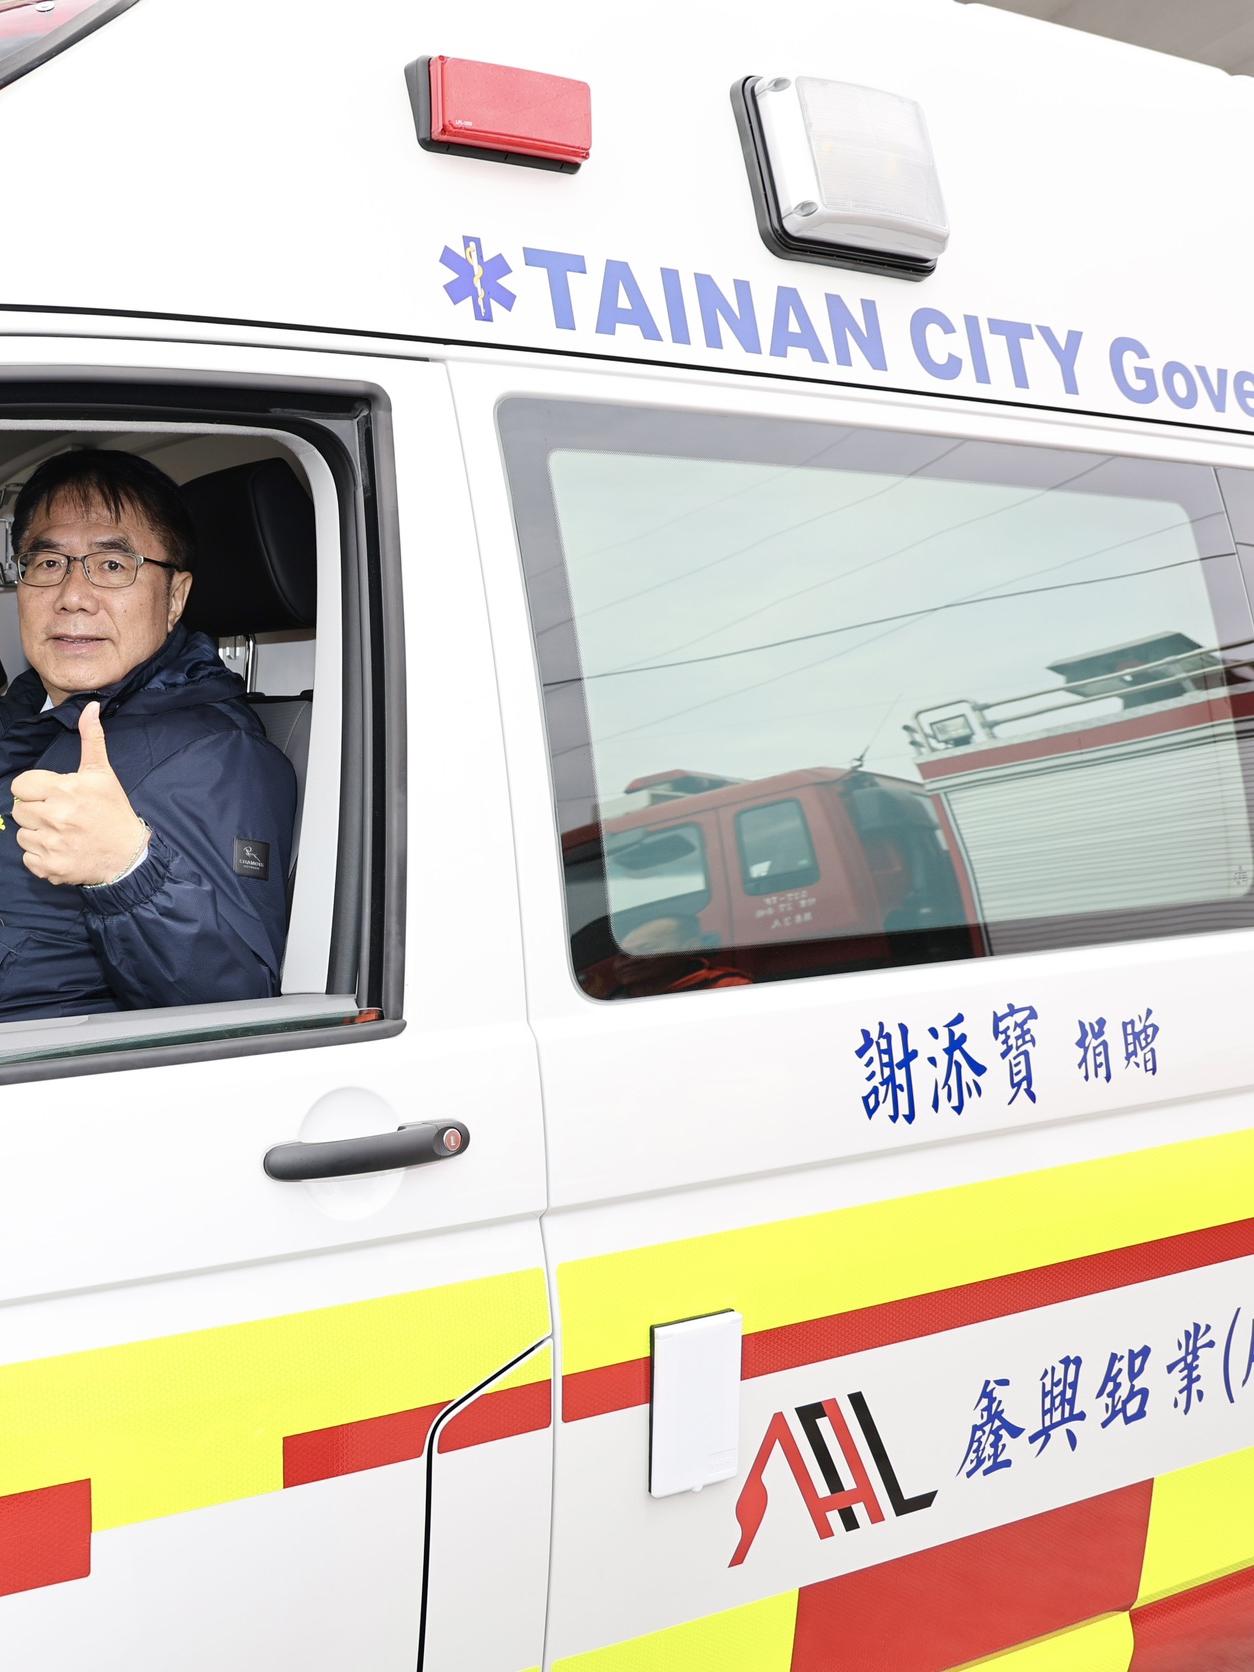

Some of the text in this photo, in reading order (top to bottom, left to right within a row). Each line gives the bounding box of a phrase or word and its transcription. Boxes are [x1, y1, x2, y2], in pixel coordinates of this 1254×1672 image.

[522, 246, 888, 372] TAINAN
[909, 307, 1084, 396] CITY
[854, 1003, 1160, 1125] 謝添寶 捐贈
[955, 1307, 1254, 1479] 鑫興鋁業(
